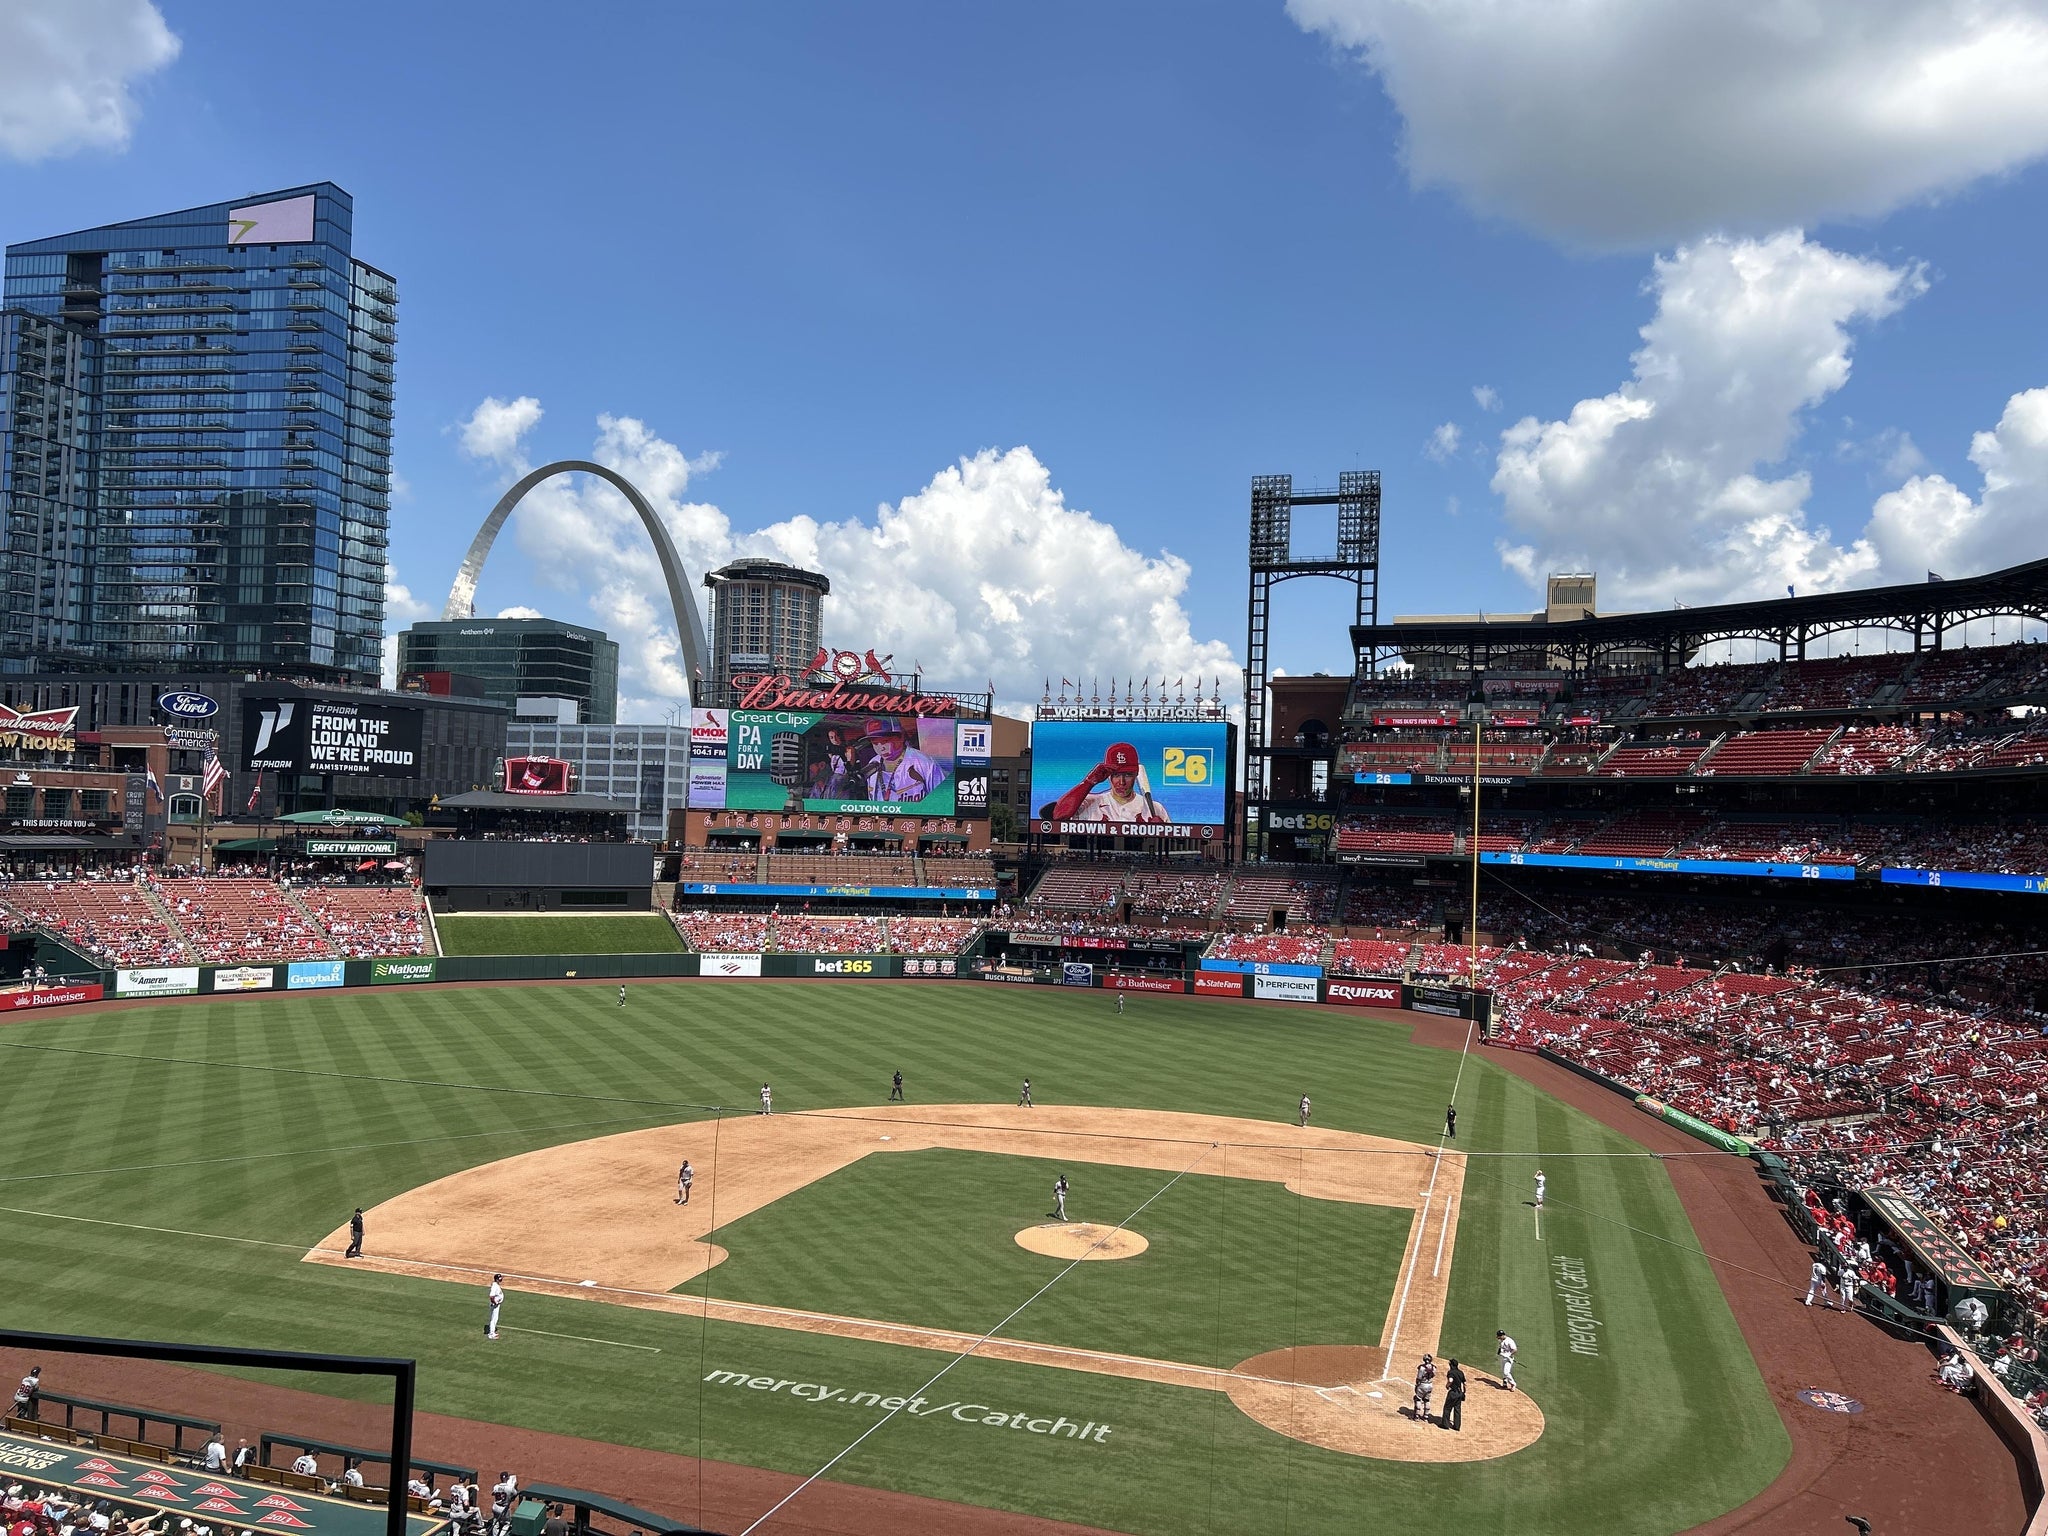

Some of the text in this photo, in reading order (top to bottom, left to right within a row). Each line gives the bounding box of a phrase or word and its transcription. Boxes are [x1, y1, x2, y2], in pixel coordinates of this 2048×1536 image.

[732, 674, 957, 714] Budweiser
[173, 694, 208, 714] Ford
[732, 710, 810, 728] Great Clips
[1054, 707, 1208, 718] WORLD CHAMPIONS
[0, 716, 76, 732] udweiser
[311, 715, 390, 734] FROM THE
[164, 726, 217, 741] Community
[311, 730, 378, 748] LOU AND
[692, 728, 726, 738] KMOX
[739, 725, 761, 745] PA
[22, 736, 76, 752] HOUSE
[310, 746, 413, 765] WE'RE PROUD
[738, 754, 764, 770] DAY
[310, 763, 370, 772] #IAM1STPHORM
[1166, 749, 1206, 783] 26
[1376, 775, 1391, 784] 26
[1425, 775, 1462, 784] BENJAMIN
[725, 816, 730, 826] 1
[736, 816, 745, 828] 2
[750, 817, 758, 828] 6
[765, 817, 774, 828] 9
[780, 818, 792, 829] 10
[798, 818, 810, 829] 14
[818, 819, 829, 830] 17
[836, 820, 850, 830] 20
[859, 820, 874, 831] 23
[880, 821, 894, 832] 24
[901, 821, 916, 832] 42
[922, 822, 937, 833] 45
[942, 822, 955, 833] 85
[1061, 822, 1190, 837] BROWN & CROUPPEN
[312, 844, 392, 852] SAFETY NATIONAL
[1510, 854, 1524, 864] 26
[1801, 866, 1819, 878] 26
[1928, 872, 2032, 889] 26 JJ
[702, 884, 716, 894] 26
[966, 890, 980, 899] 26
[1013, 933, 1056, 942] Schnucks
[815, 959, 872, 973] bet365
[1069, 965, 1086, 974] Ford
[1254, 963, 1269, 974] 26
[1128, 979, 1171, 989] Budweiser
[1266, 981, 1315, 990] PERFICIENT
[126, 989, 190, 997] AMEREN.COM/REBATES
[1328, 985, 1395, 999] EQUIFAX
[1551, 1256, 1603, 1356] mercy.net/CatchIt
[703, 1369, 1112, 1443] mercy.net/CatchIt
[8, 1446, 68, 1462] LEAGUE
[297, 1461, 306, 1473] 15
[205, 1500, 230, 1509] 1987
[264, 1499, 289, 1508] 2004
